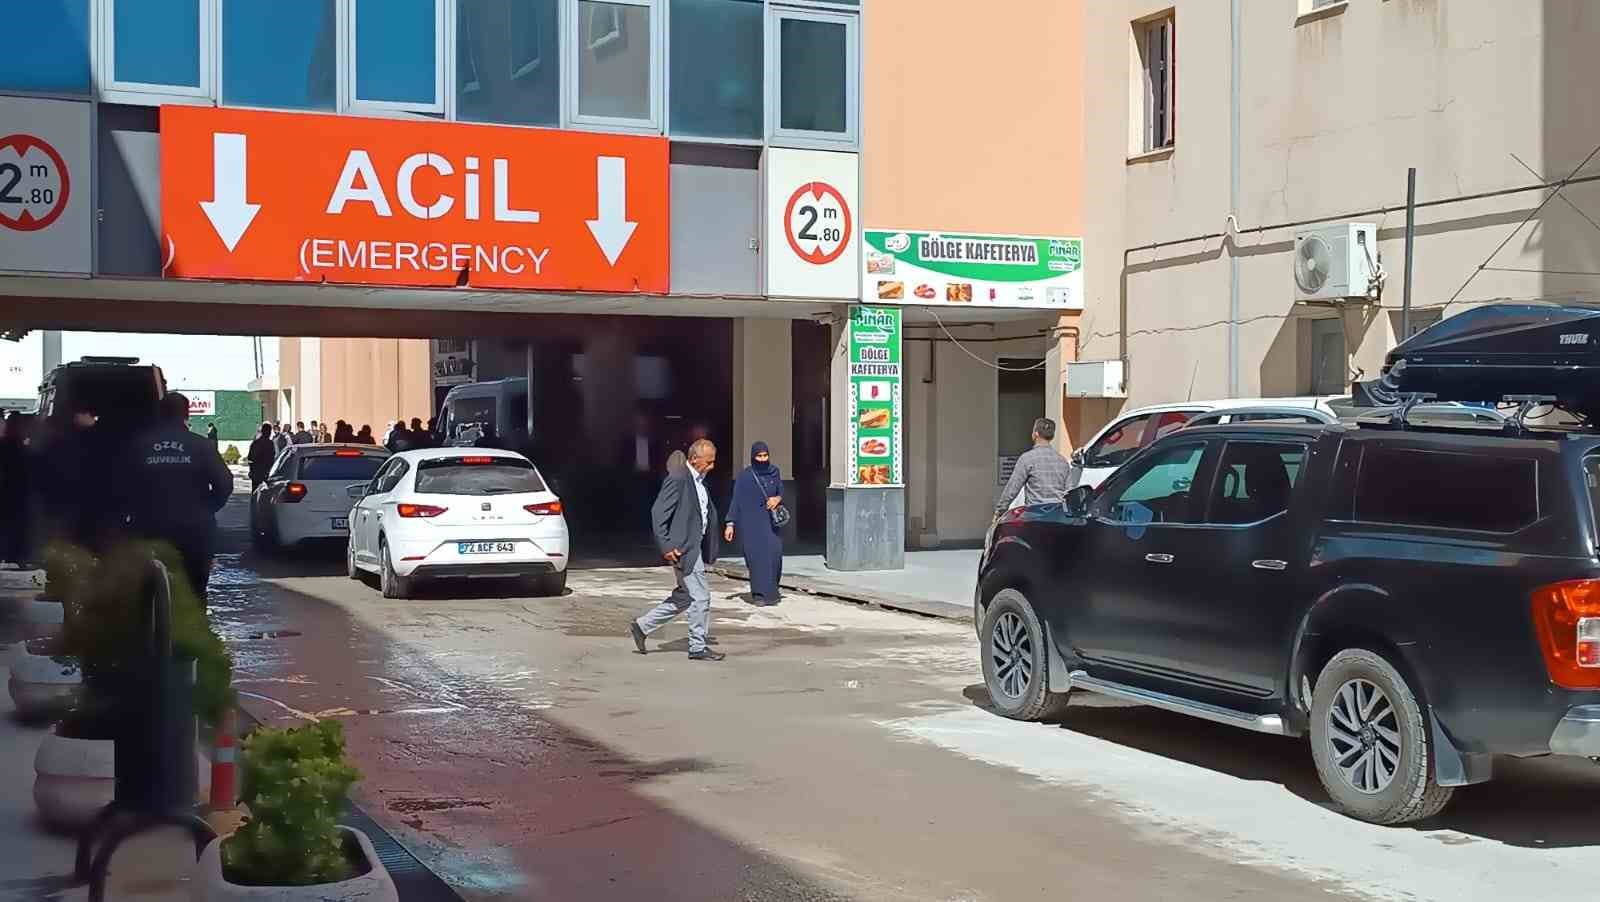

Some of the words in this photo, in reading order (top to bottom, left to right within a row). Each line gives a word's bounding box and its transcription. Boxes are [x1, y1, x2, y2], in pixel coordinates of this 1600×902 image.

[921, 238, 963, 259] BÖLGE
[965, 241, 1036, 262] KAFETERYA
[1559, 333, 1589, 345] THULE
[861, 347, 888, 360] BÖLGE
[851, 364, 898, 375] KAFETERYA
